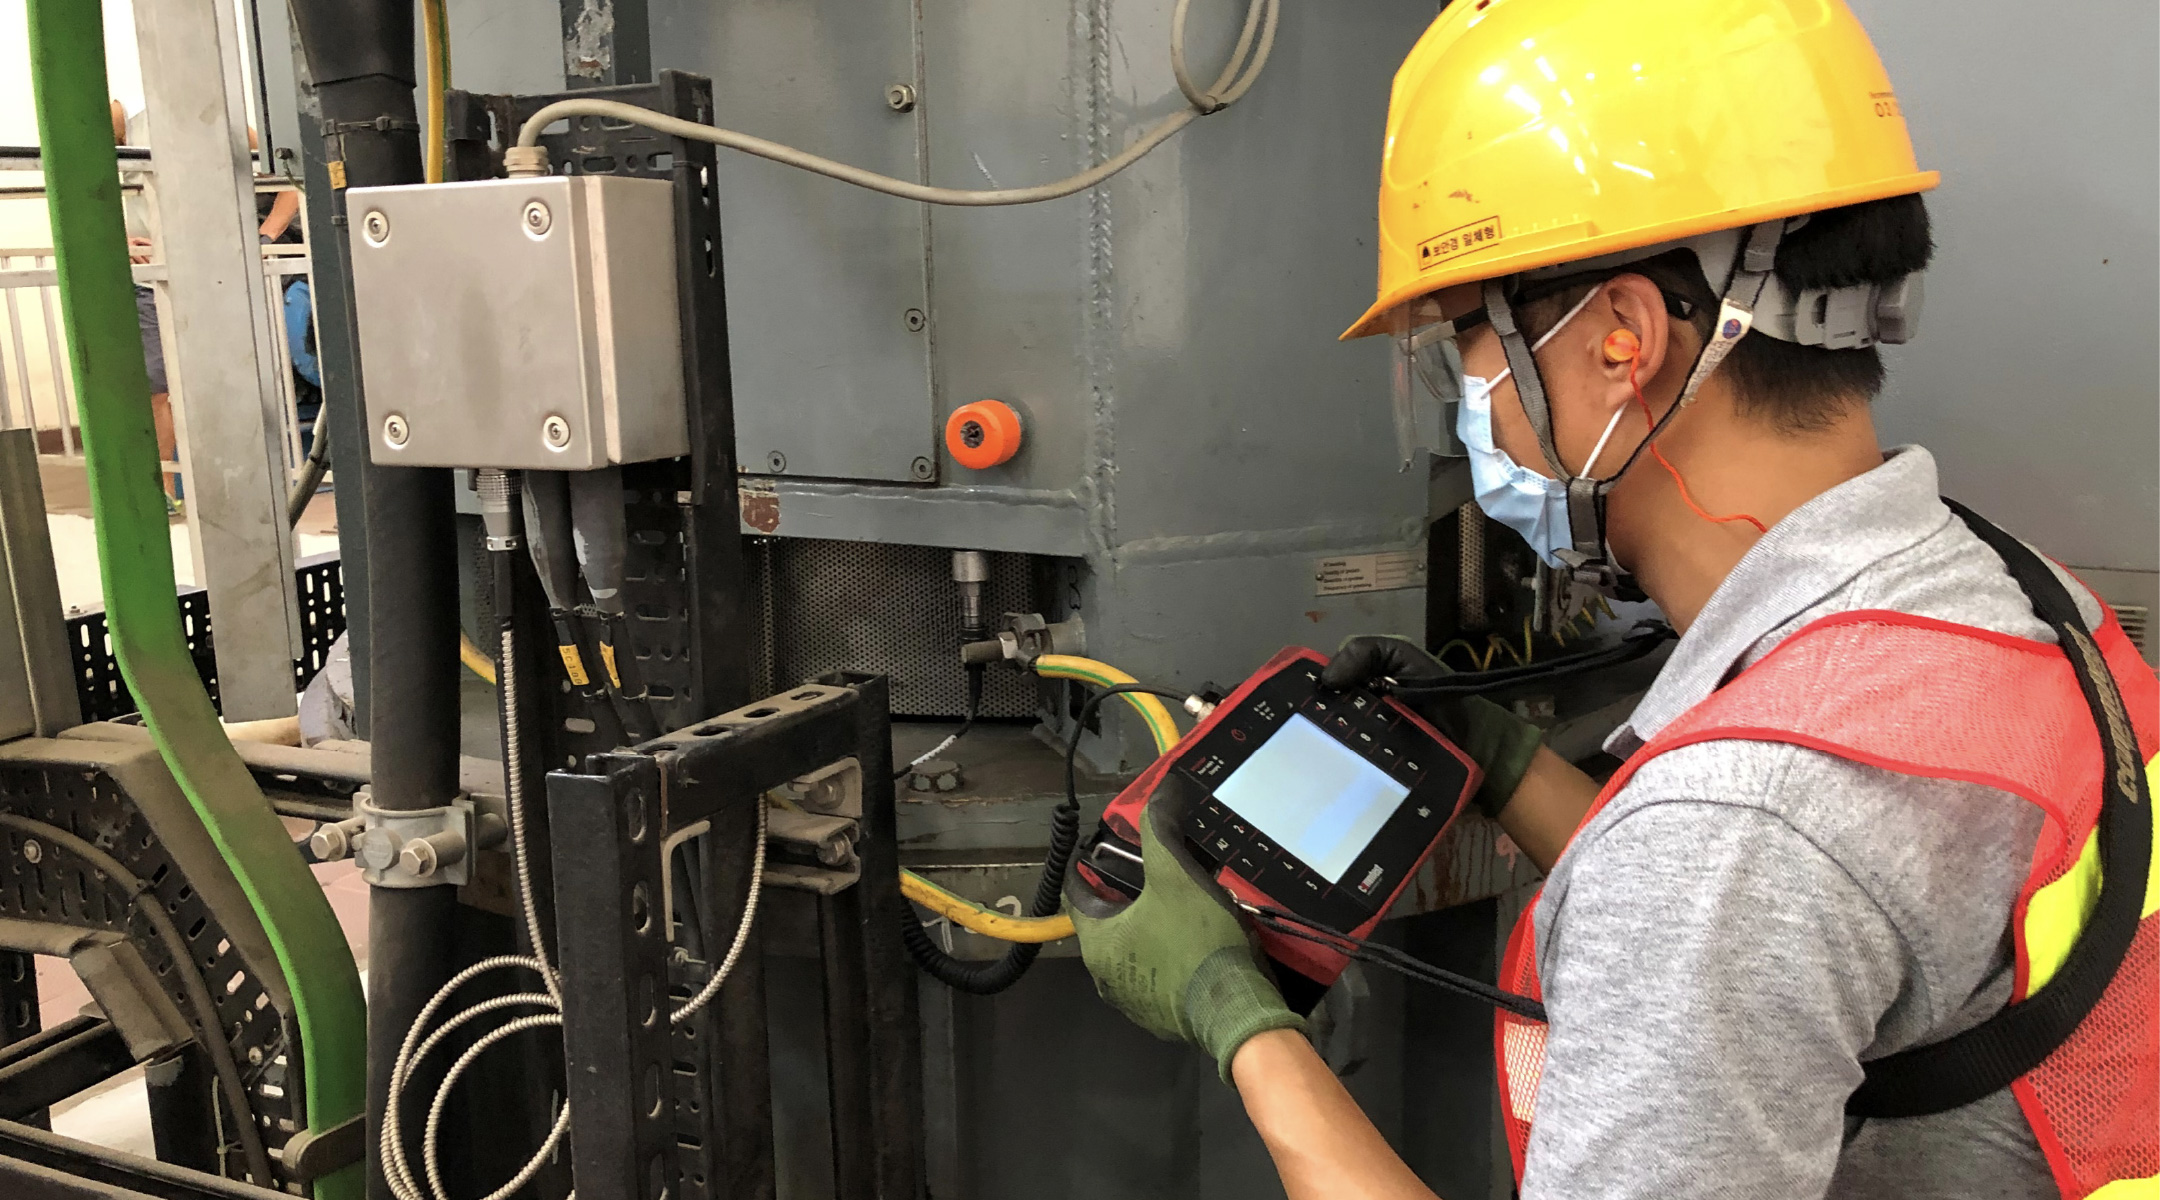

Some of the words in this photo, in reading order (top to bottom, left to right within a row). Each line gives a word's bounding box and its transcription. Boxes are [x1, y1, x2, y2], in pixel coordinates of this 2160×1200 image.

[1433, 236, 1459, 257] 보안경
[1462, 224, 1495, 247] 일체형
[1316, 701, 1327, 710] 6
[1337, 716, 1348, 726] 7
[1360, 732, 1371, 742] 8
[1383, 748, 1395, 756] 9
[1407, 761, 1419, 771] 0
[1233, 824, 1245, 834] 2
[1257, 842, 1269, 852] 3
[1282, 861, 1294, 871] 4
[1305, 880, 1318, 890] 5
